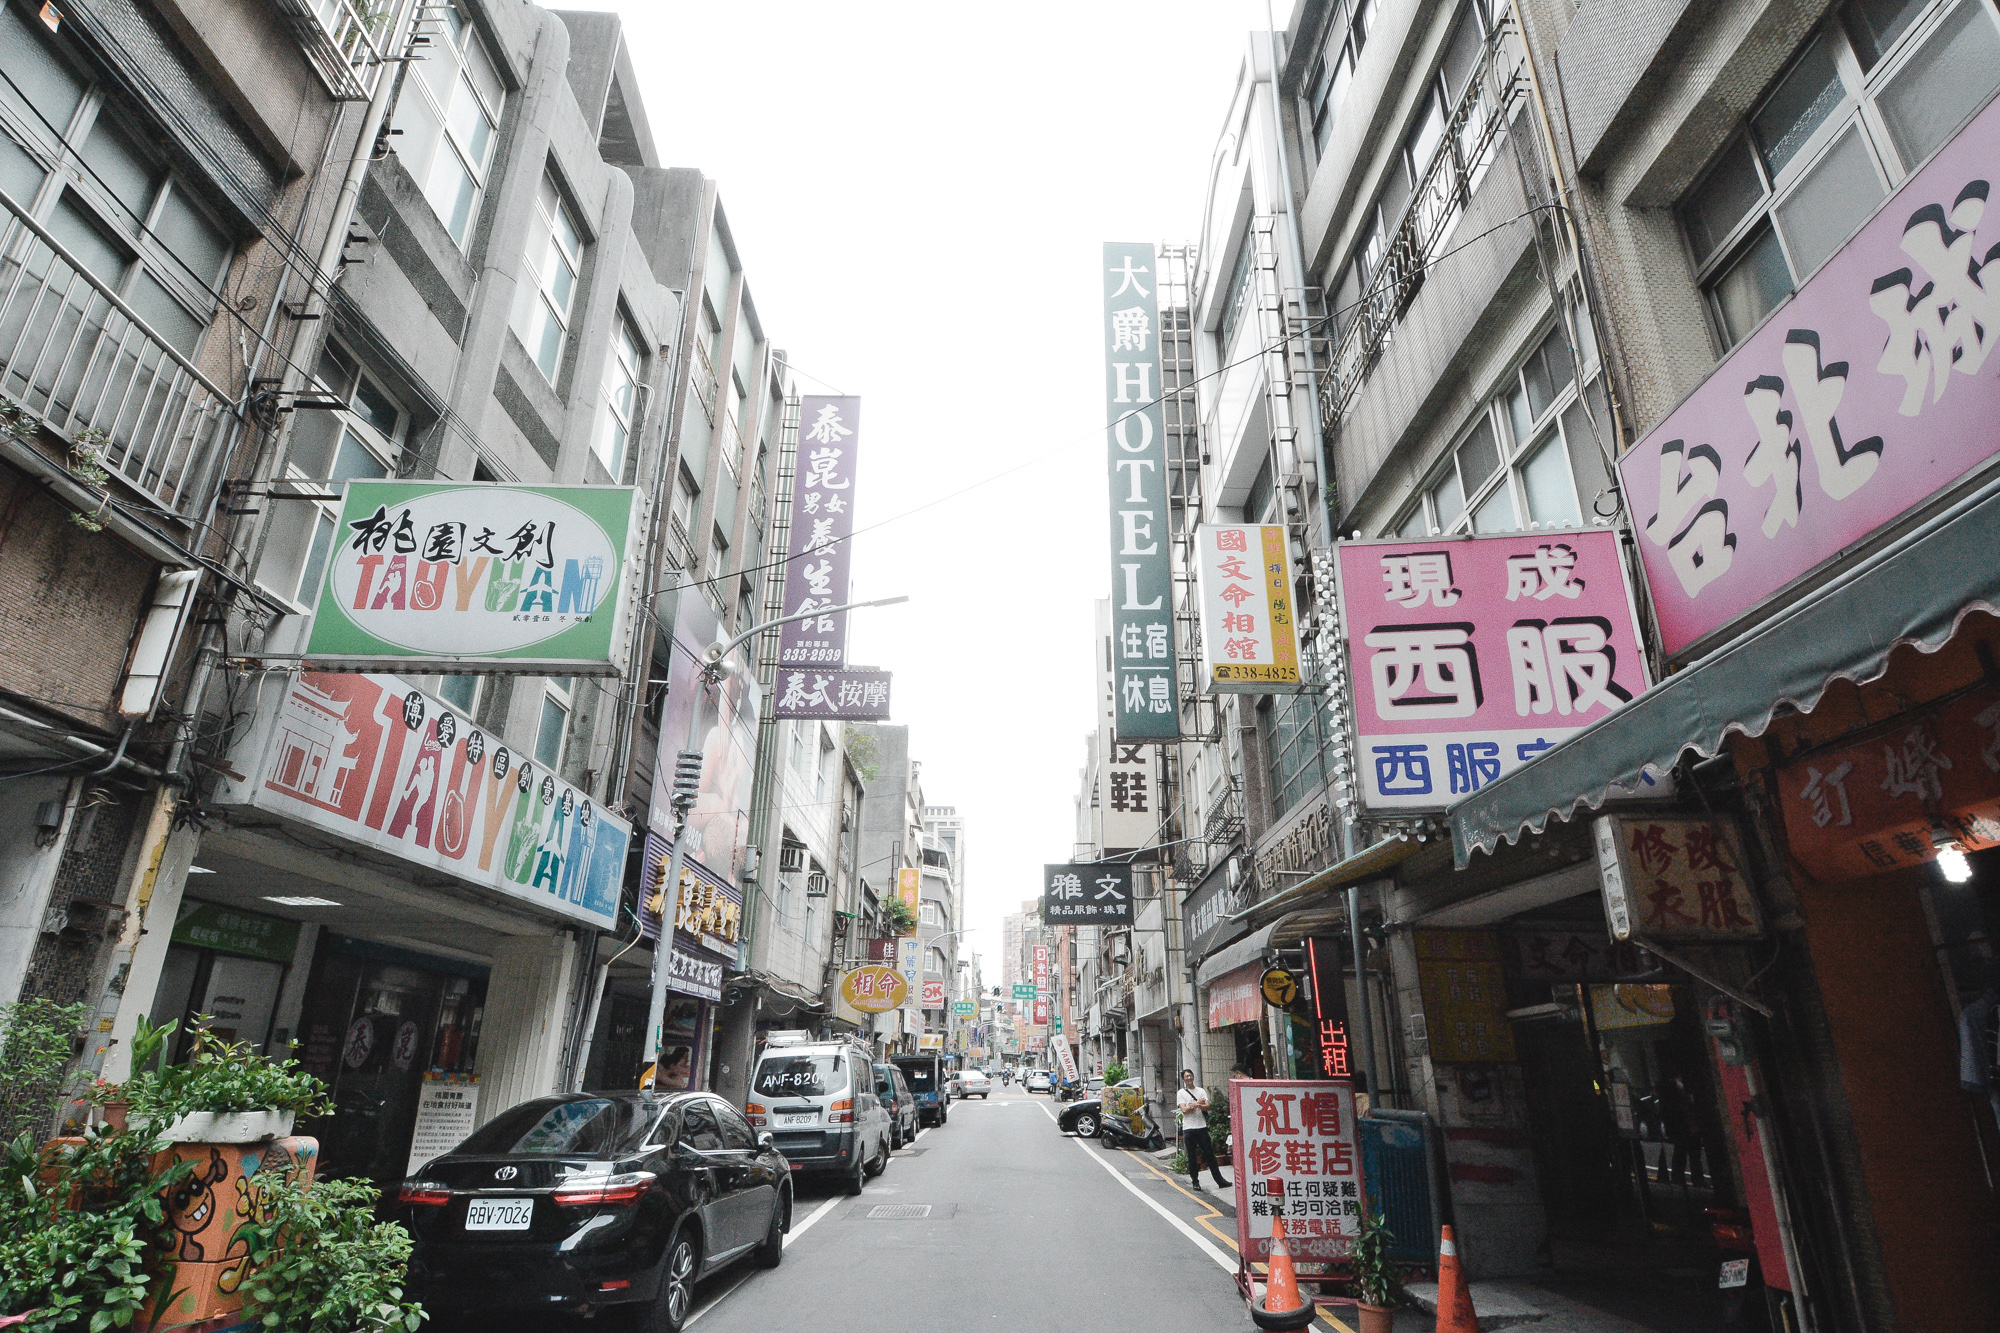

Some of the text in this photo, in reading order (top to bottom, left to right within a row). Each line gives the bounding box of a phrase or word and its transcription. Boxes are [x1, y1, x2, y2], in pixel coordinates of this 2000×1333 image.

[1112, 362, 1163, 610] HOTEL
[1381, 544, 1586, 609] 現成
[782, 648, 842, 662] 333-2939
[1120, 621, 1168, 659] 住宿
[1233, 666, 1297, 680] 338-4825
[1364, 616, 1634, 721] 西服
[778, 671, 888, 713] 泰式按摩
[1122, 673, 1172, 714] 休息
[1051, 872, 1126, 900] 雅文
[924, 985, 943, 998] OK
[1060, 1048, 1076, 1080] YAMAHA
[1320, 1019, 1351, 1077] 出租
[1255, 1090, 1341, 1137] 紅帽
[1249, 1139, 1354, 1176] 修鞋店
[1251, 1181, 1358, 1198] 如任何疑難
[467, 1206, 532, 1225] RBV-7026
